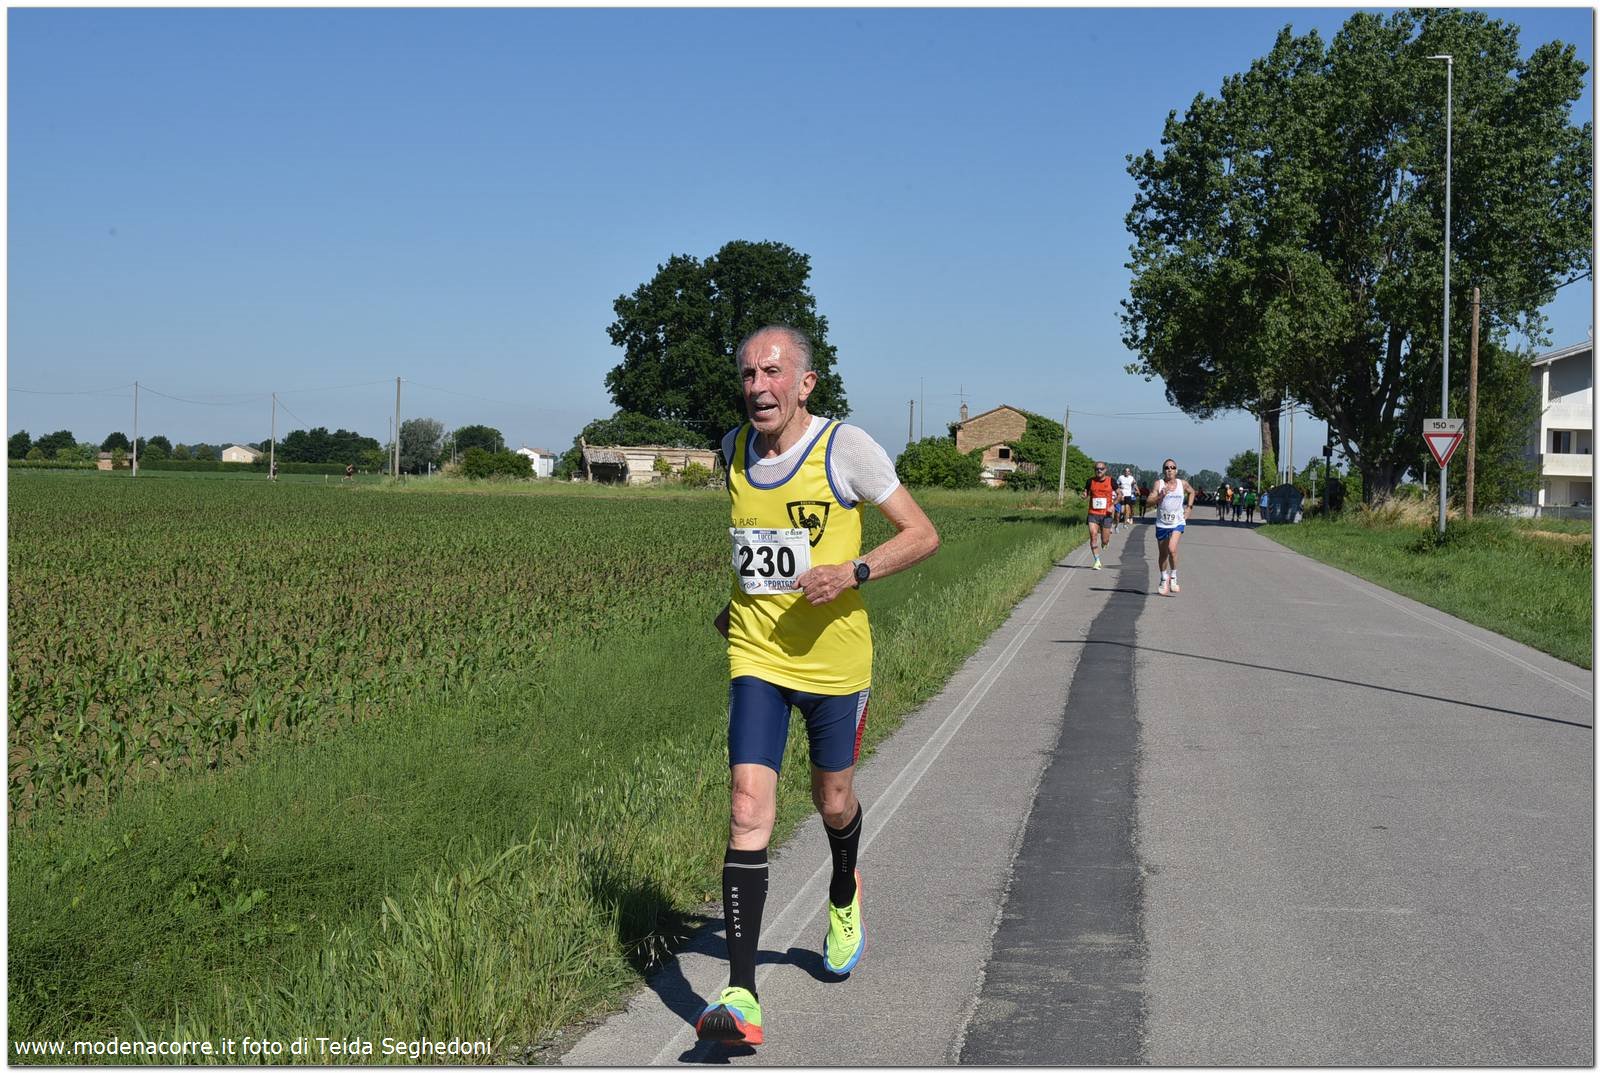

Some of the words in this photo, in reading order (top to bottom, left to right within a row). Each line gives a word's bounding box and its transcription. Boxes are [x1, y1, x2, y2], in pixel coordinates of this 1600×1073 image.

[1432, 421, 1447, 429] 150
[739, 517, 758, 527] PLAST
[1163, 513, 1176, 521] 179
[738, 545, 796, 578] 230
[731, 886, 742, 938] OXYBURN
